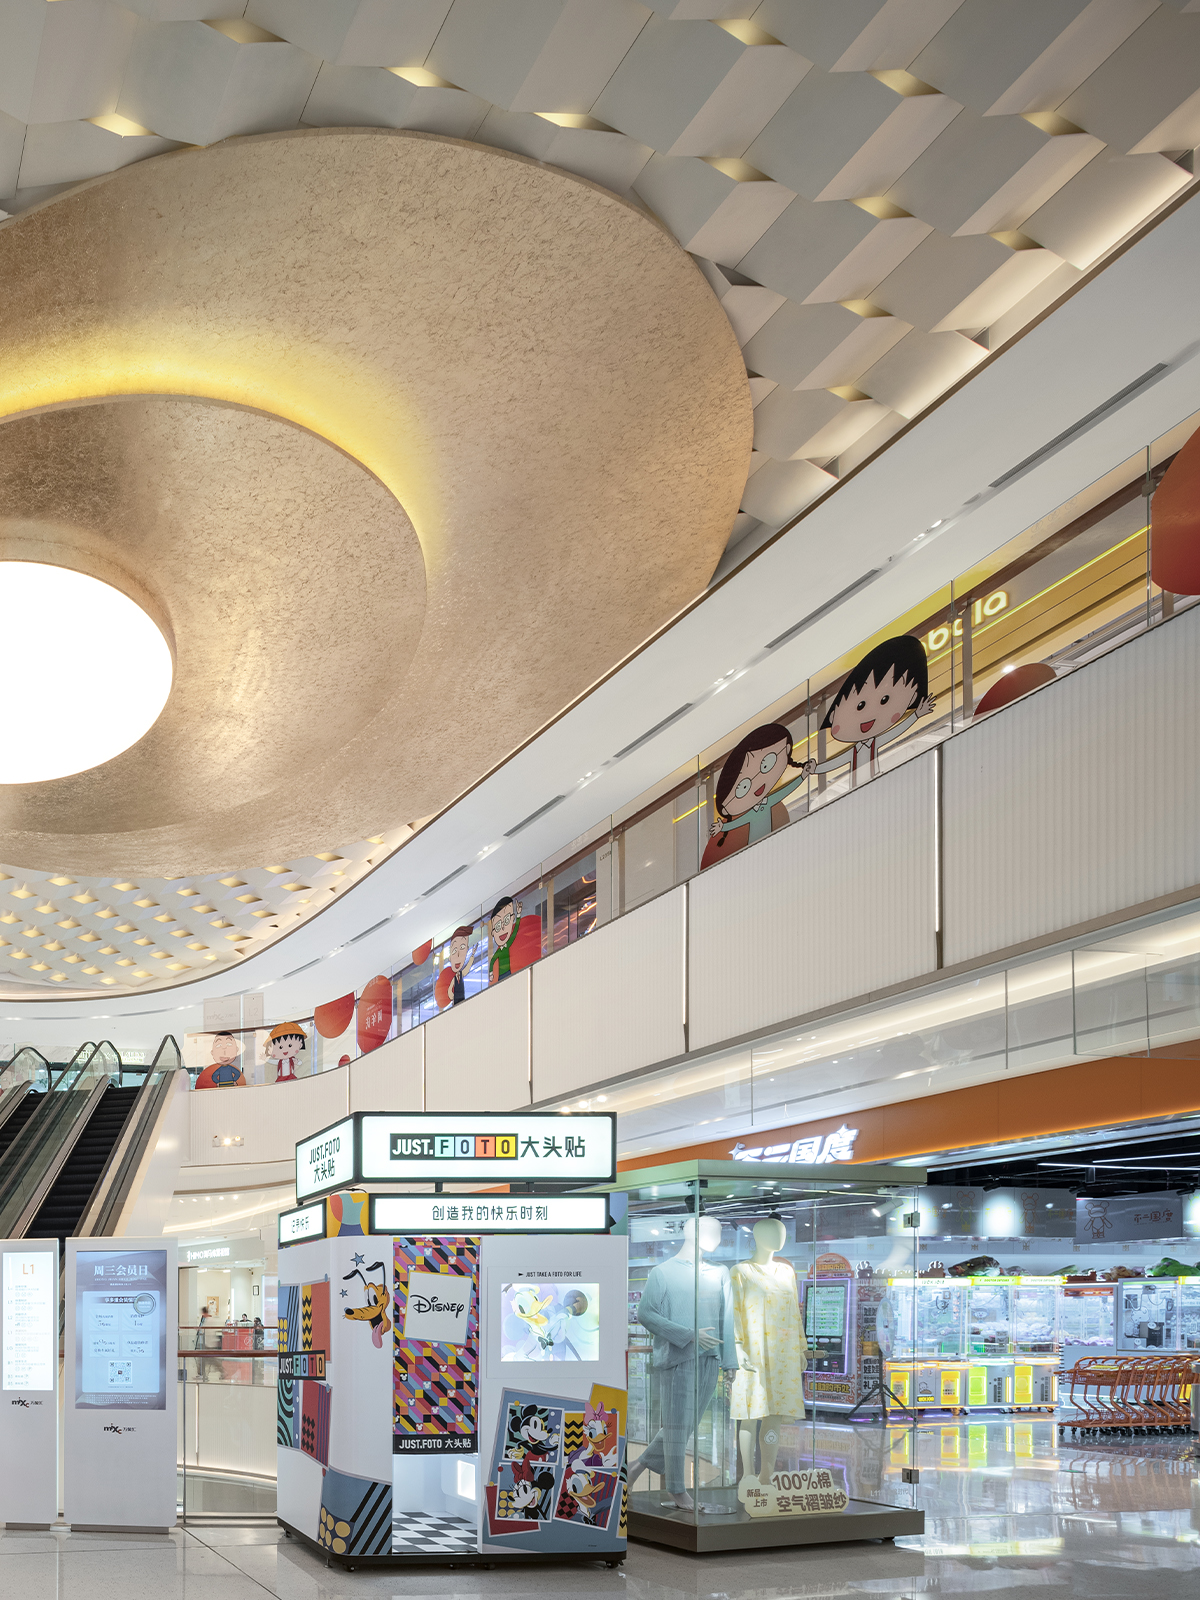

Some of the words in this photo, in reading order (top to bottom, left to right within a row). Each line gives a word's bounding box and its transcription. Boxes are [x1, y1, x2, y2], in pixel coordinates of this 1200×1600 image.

[309, 1136, 340, 1164] JUST.FOTO
[392, 1139, 510, 1155] JUST.FOTO
[520, 1136, 585, 1158] 大头贴
[314, 1158, 335, 1183] 大头贴
[432, 1206, 548, 1221] 创造我的快乐时刻
[1133, 1208, 1173, 1223] 不二国度
[22, 1263, 34, 1275] L1
[94, 1264, 148, 1276] 周三会员日
[410, 1295, 465, 1318] Disney
[280, 1357, 322, 1374] JUST.FOTO
[863, 1364, 880, 1374] 娃娃
[809, 1382, 850, 1393] 自助购币处
[399, 1439, 442, 1449] JUST.FOTO
[445, 1438, 471, 1448] 大头贴
[772, 1471, 832, 1491] 100%棉
[747, 1489, 761, 1498] 新品
[753, 1499, 768, 1508] 上市
[776, 1492, 847, 1513] 空气褶皱纱
